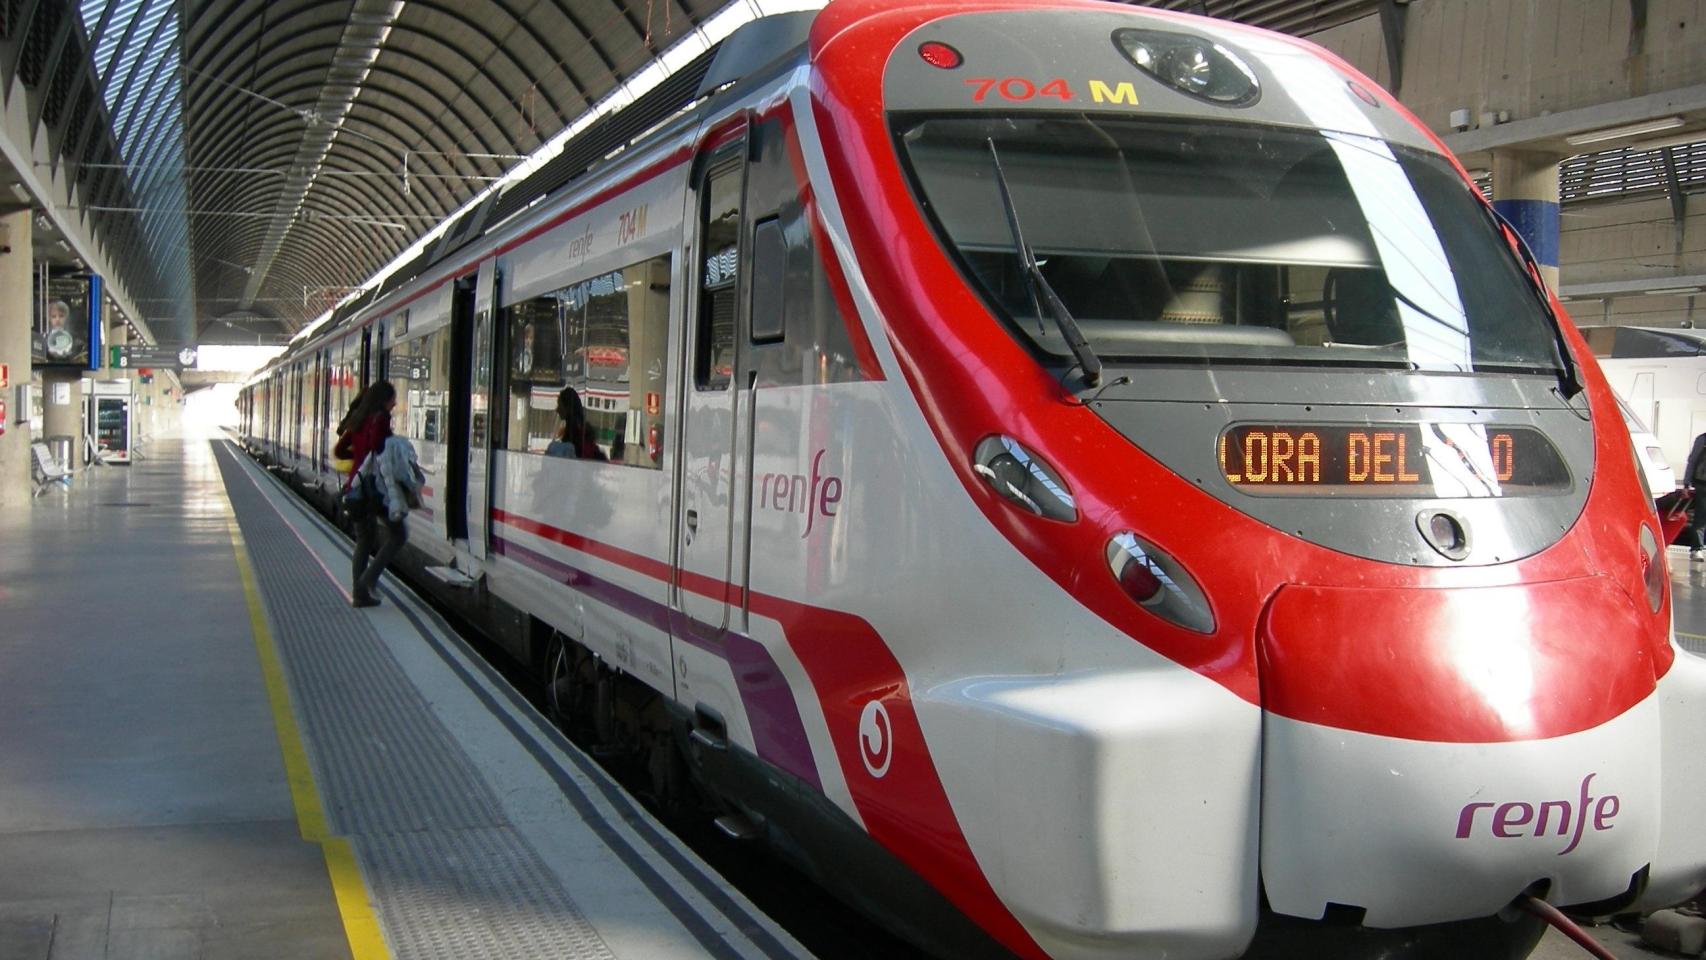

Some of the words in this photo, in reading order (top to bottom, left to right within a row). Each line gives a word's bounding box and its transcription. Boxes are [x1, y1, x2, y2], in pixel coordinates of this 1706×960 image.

[964, 77, 1077, 103] 704
[1088, 79, 1139, 106] M
[568, 223, 593, 267] renfe
[1220, 431, 1320, 482] LORA
[1348, 431, 1420, 482] DEL
[760, 448, 843, 539] renfe
[1455, 772, 1620, 856] renfe
